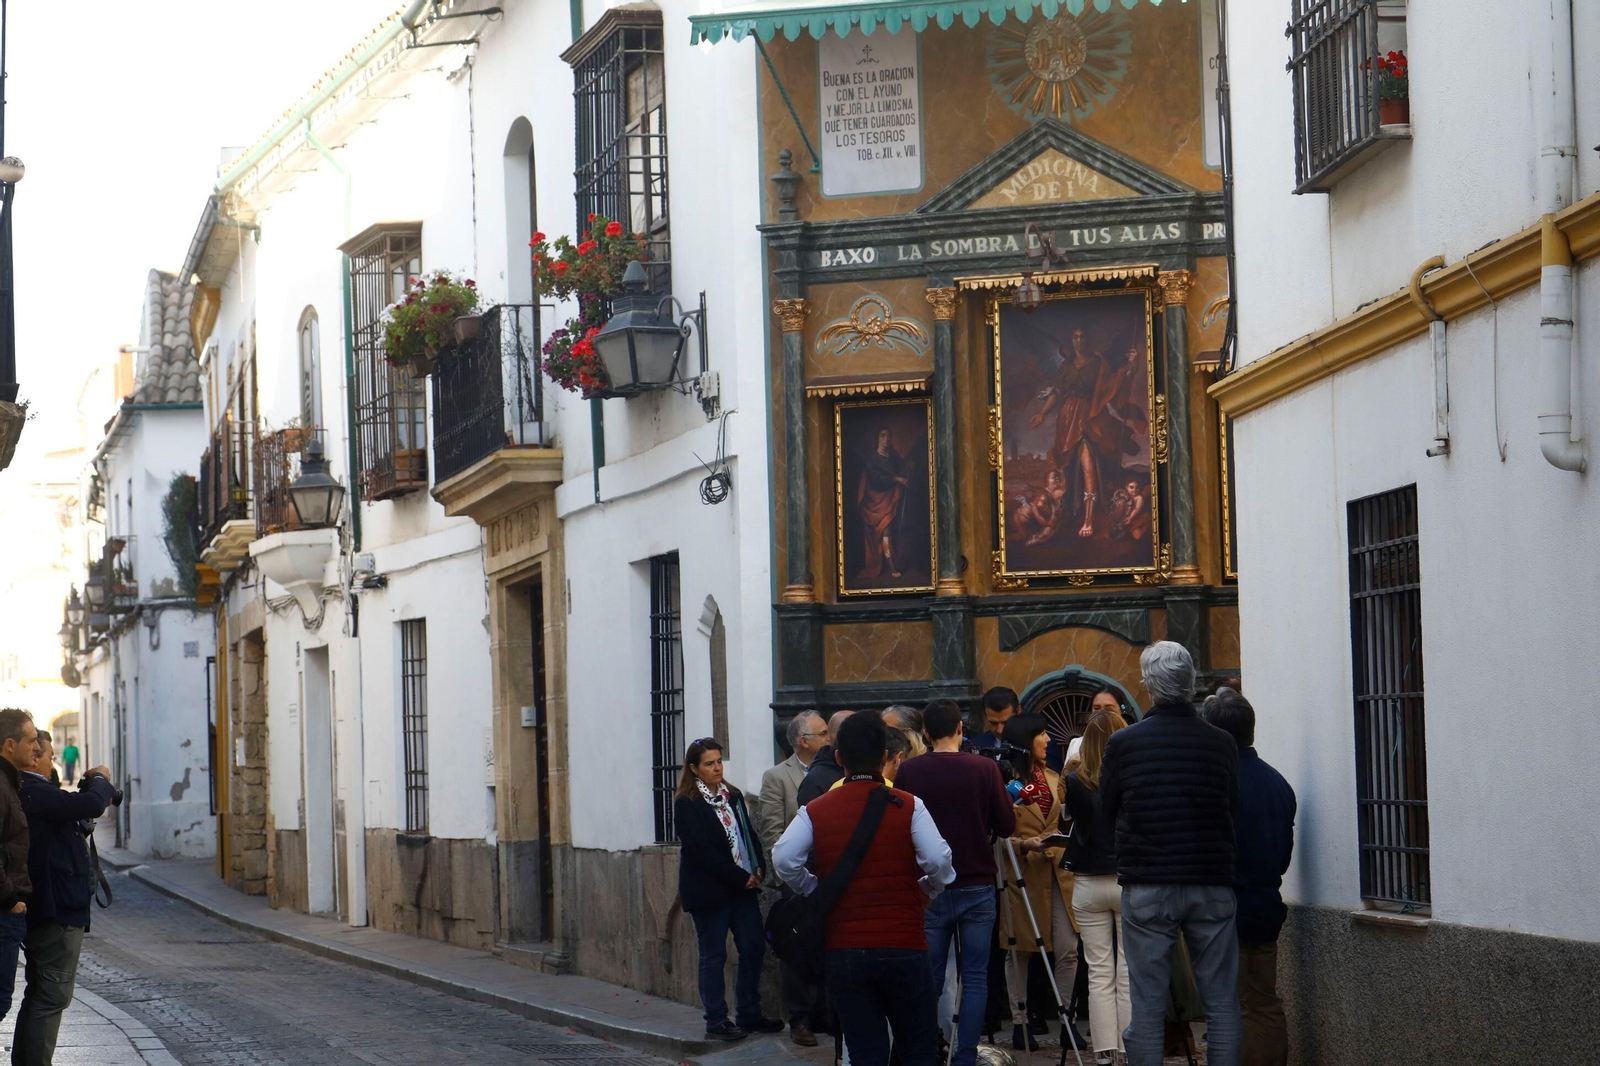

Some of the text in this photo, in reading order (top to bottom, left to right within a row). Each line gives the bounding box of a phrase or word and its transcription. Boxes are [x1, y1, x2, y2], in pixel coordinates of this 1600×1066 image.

[823, 66, 914, 87] BUENA ES LA ORACION
[836, 83, 903, 102] CON EL AYUNO
[826, 98, 913, 117] Y MEJOR LA LIMOSNA
[825, 113, 916, 134] QUE TENER GUARDADOS
[836, 129, 906, 147] LOS TESOROS
[998, 157, 1099, 203] MEDICINA
[820, 246, 876, 268] BAXO
[897, 244, 923, 261] LA
[930, 234, 1020, 257] SOMBRA
[1069, 227, 1112, 246] TUS
[1119, 222, 1181, 243] ALAS
